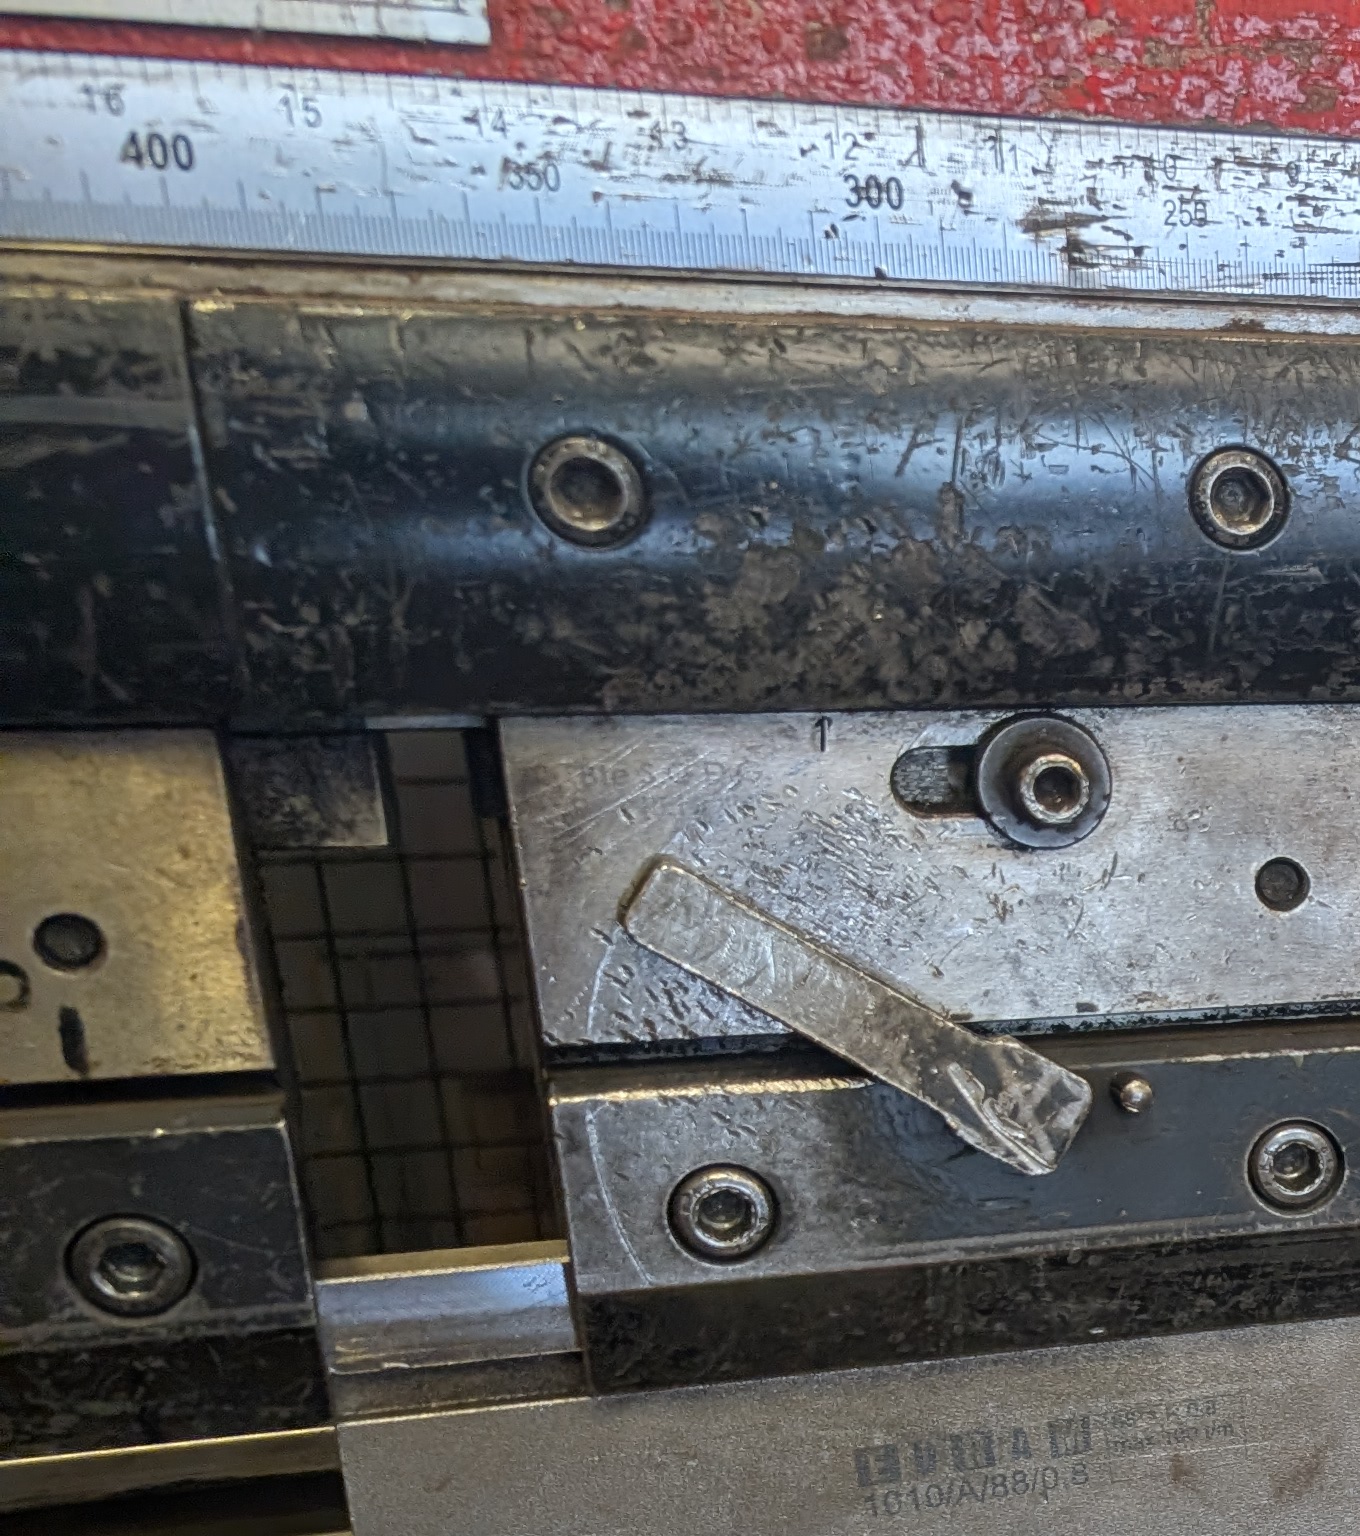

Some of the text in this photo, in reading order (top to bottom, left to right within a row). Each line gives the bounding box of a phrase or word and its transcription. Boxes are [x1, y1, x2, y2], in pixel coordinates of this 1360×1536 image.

[280, 83, 322, 129] 15
[826, 132, 858, 161] 12
[122, 132, 195, 172] 400
[843, 173, 903, 211] 300
[1163, 199, 1208, 228] 250
